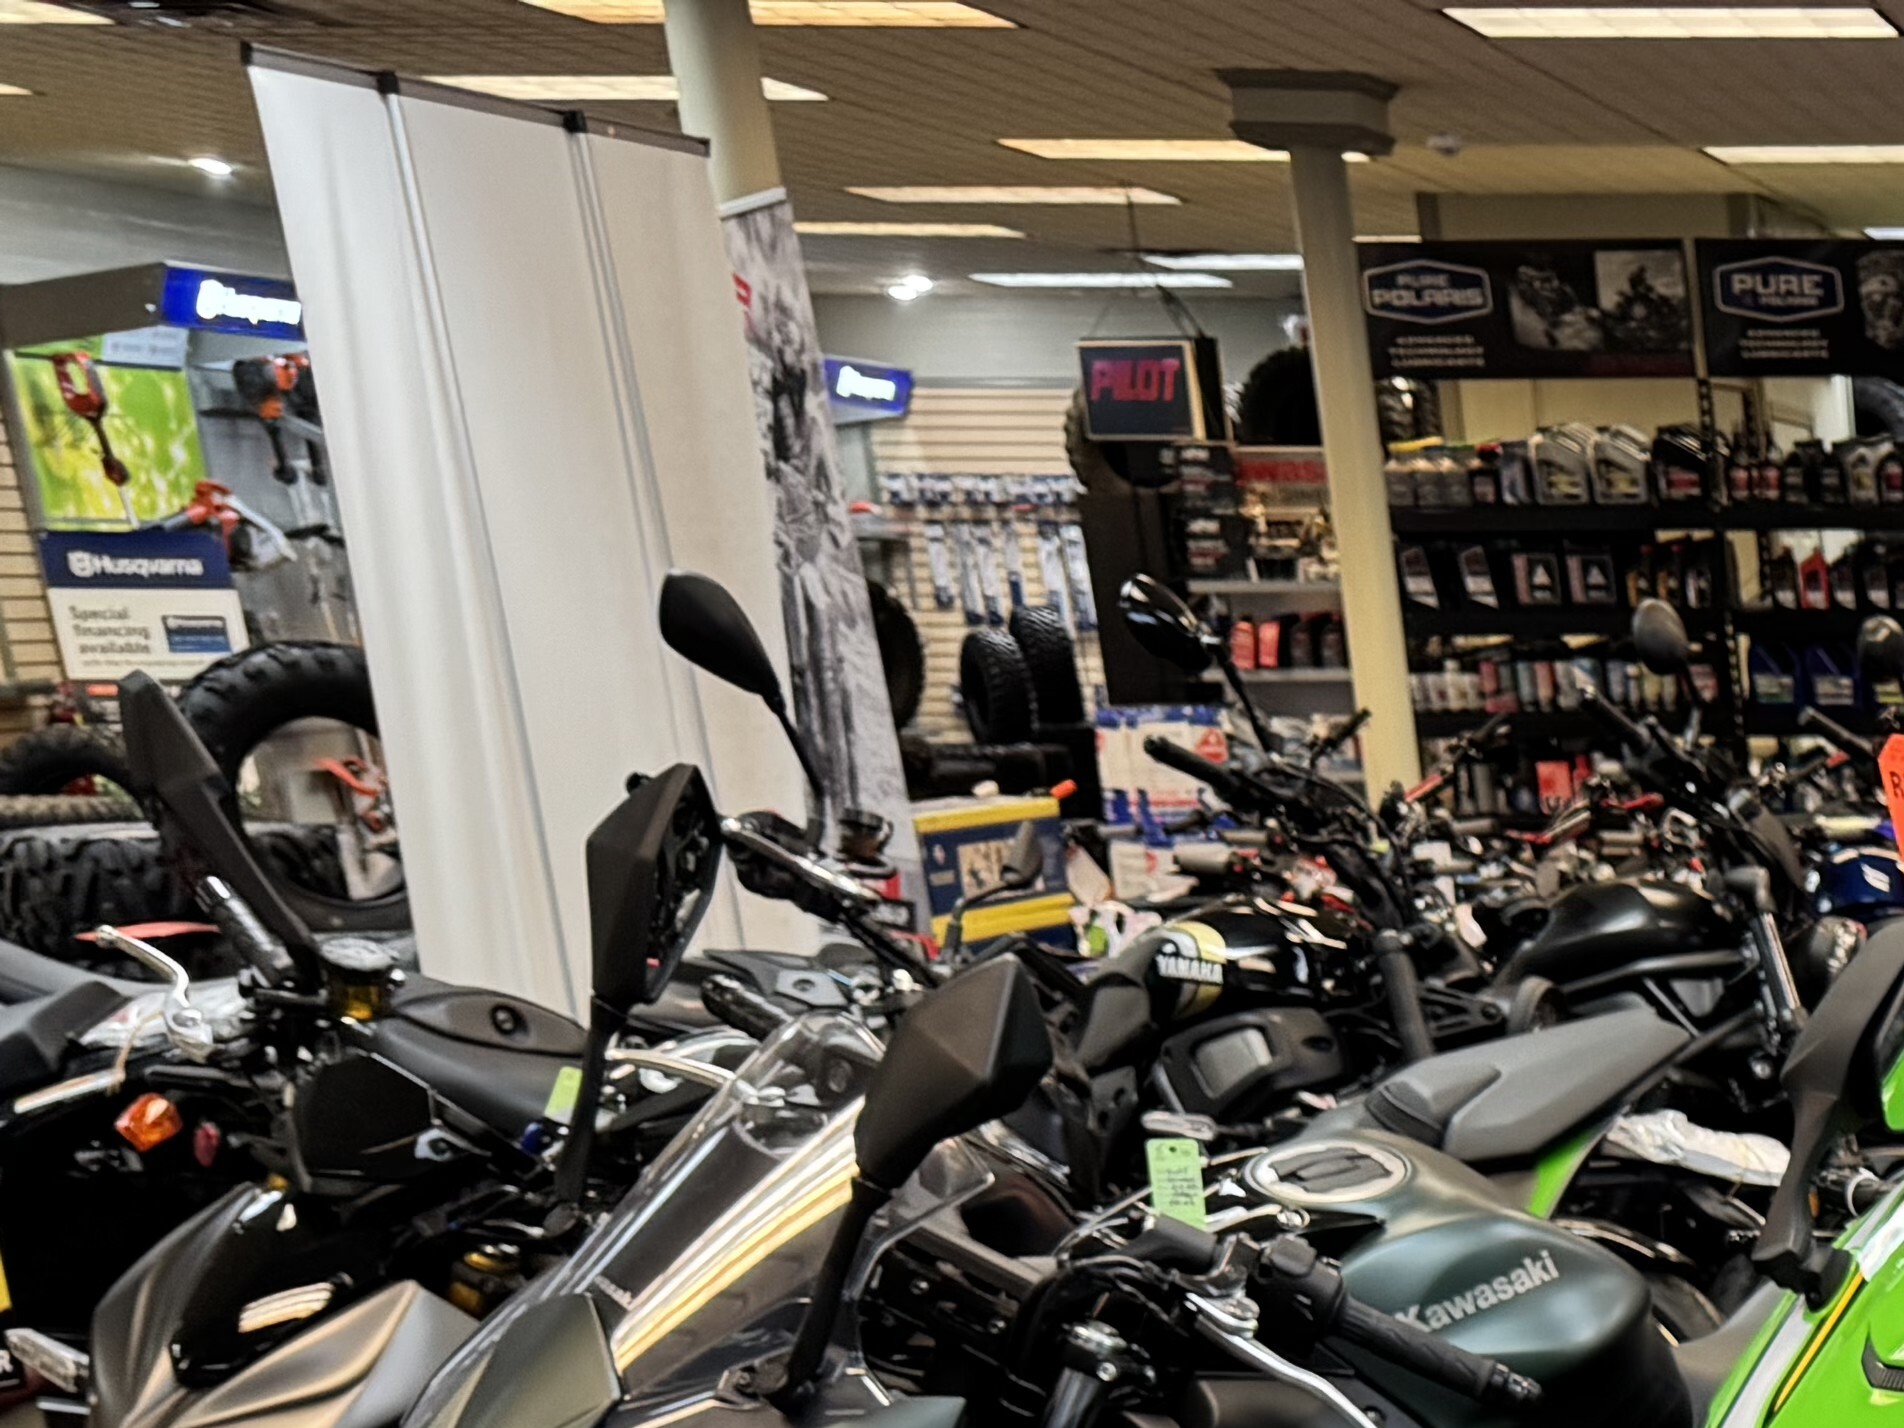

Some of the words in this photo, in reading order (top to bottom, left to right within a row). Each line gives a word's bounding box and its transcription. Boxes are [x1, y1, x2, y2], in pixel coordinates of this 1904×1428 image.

[1372, 287, 1484, 307] POLARIS
[1730, 273, 1824, 297] PURE
[1090, 357, 1180, 402] PILOT
[98, 555, 204, 578] Husqvarna
[1156, 954, 1224, 984] YAMAHA
[1394, 1250, 1559, 1333] Kawasaki
